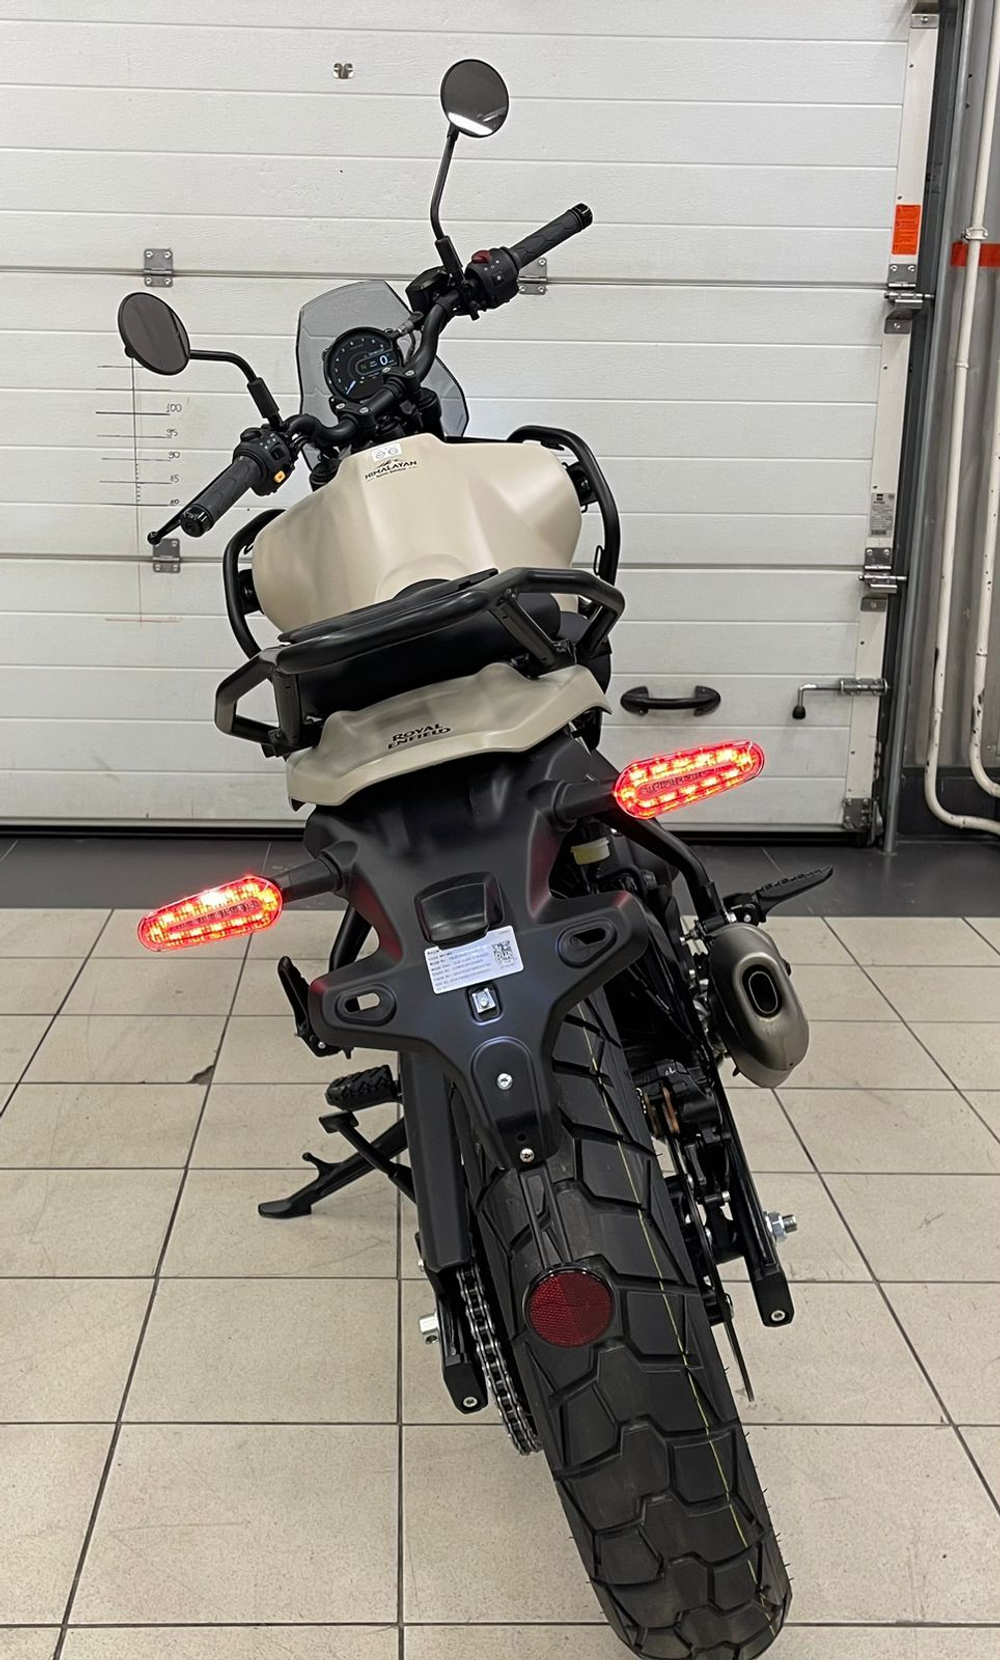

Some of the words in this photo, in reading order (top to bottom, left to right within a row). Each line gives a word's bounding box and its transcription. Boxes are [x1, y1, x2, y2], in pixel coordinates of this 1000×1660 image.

[166, 403, 182, 412] 100
[166, 428, 178, 439] 95
[168, 451, 180, 459] 90
[365, 460, 417, 479] HIMALAYAN
[388, 727, 451, 749] ENFIELD
[392, 723, 443, 741] ROYAL
